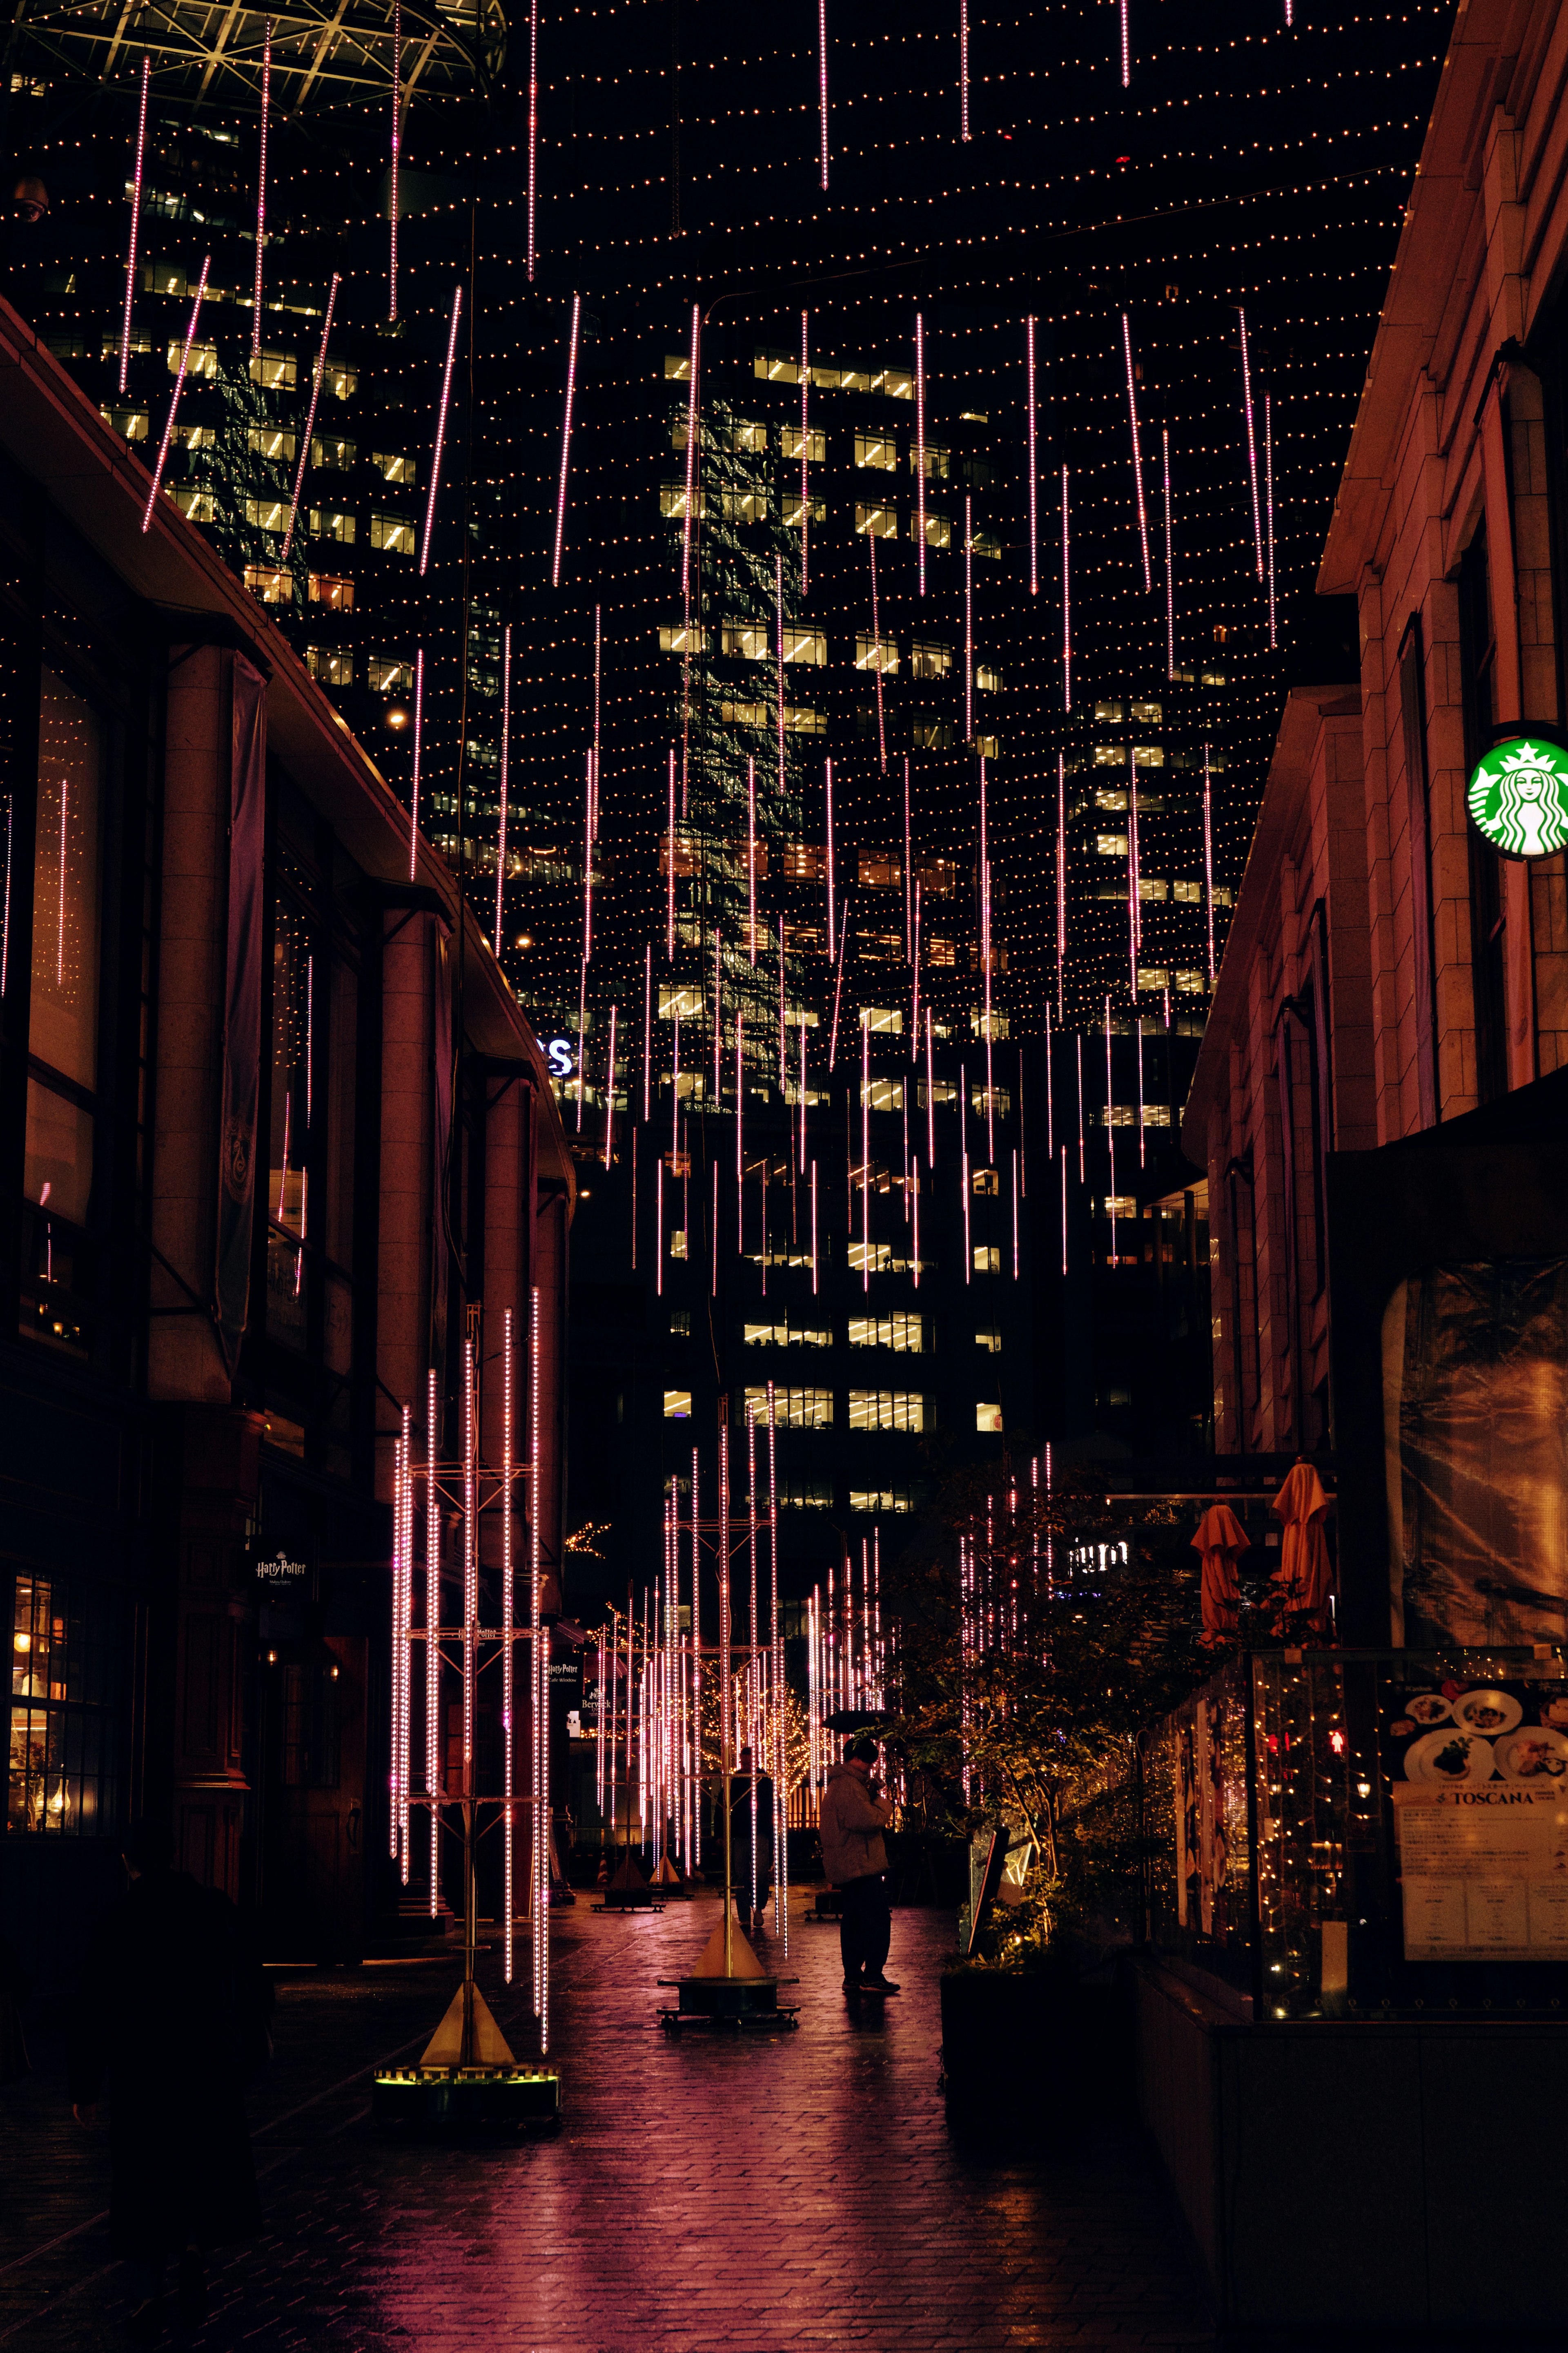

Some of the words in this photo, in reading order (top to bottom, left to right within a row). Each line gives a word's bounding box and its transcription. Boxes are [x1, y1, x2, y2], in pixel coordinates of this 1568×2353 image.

[256, 1562, 281, 1578] Harry
[281, 1560, 306, 1578] Potter
[548, 1665, 562, 1675] Harry
[562, 1664, 578, 1675] Potter
[582, 1700, 611, 1708] Berwck
[1451, 1791, 1534, 1804] TOSCANA
